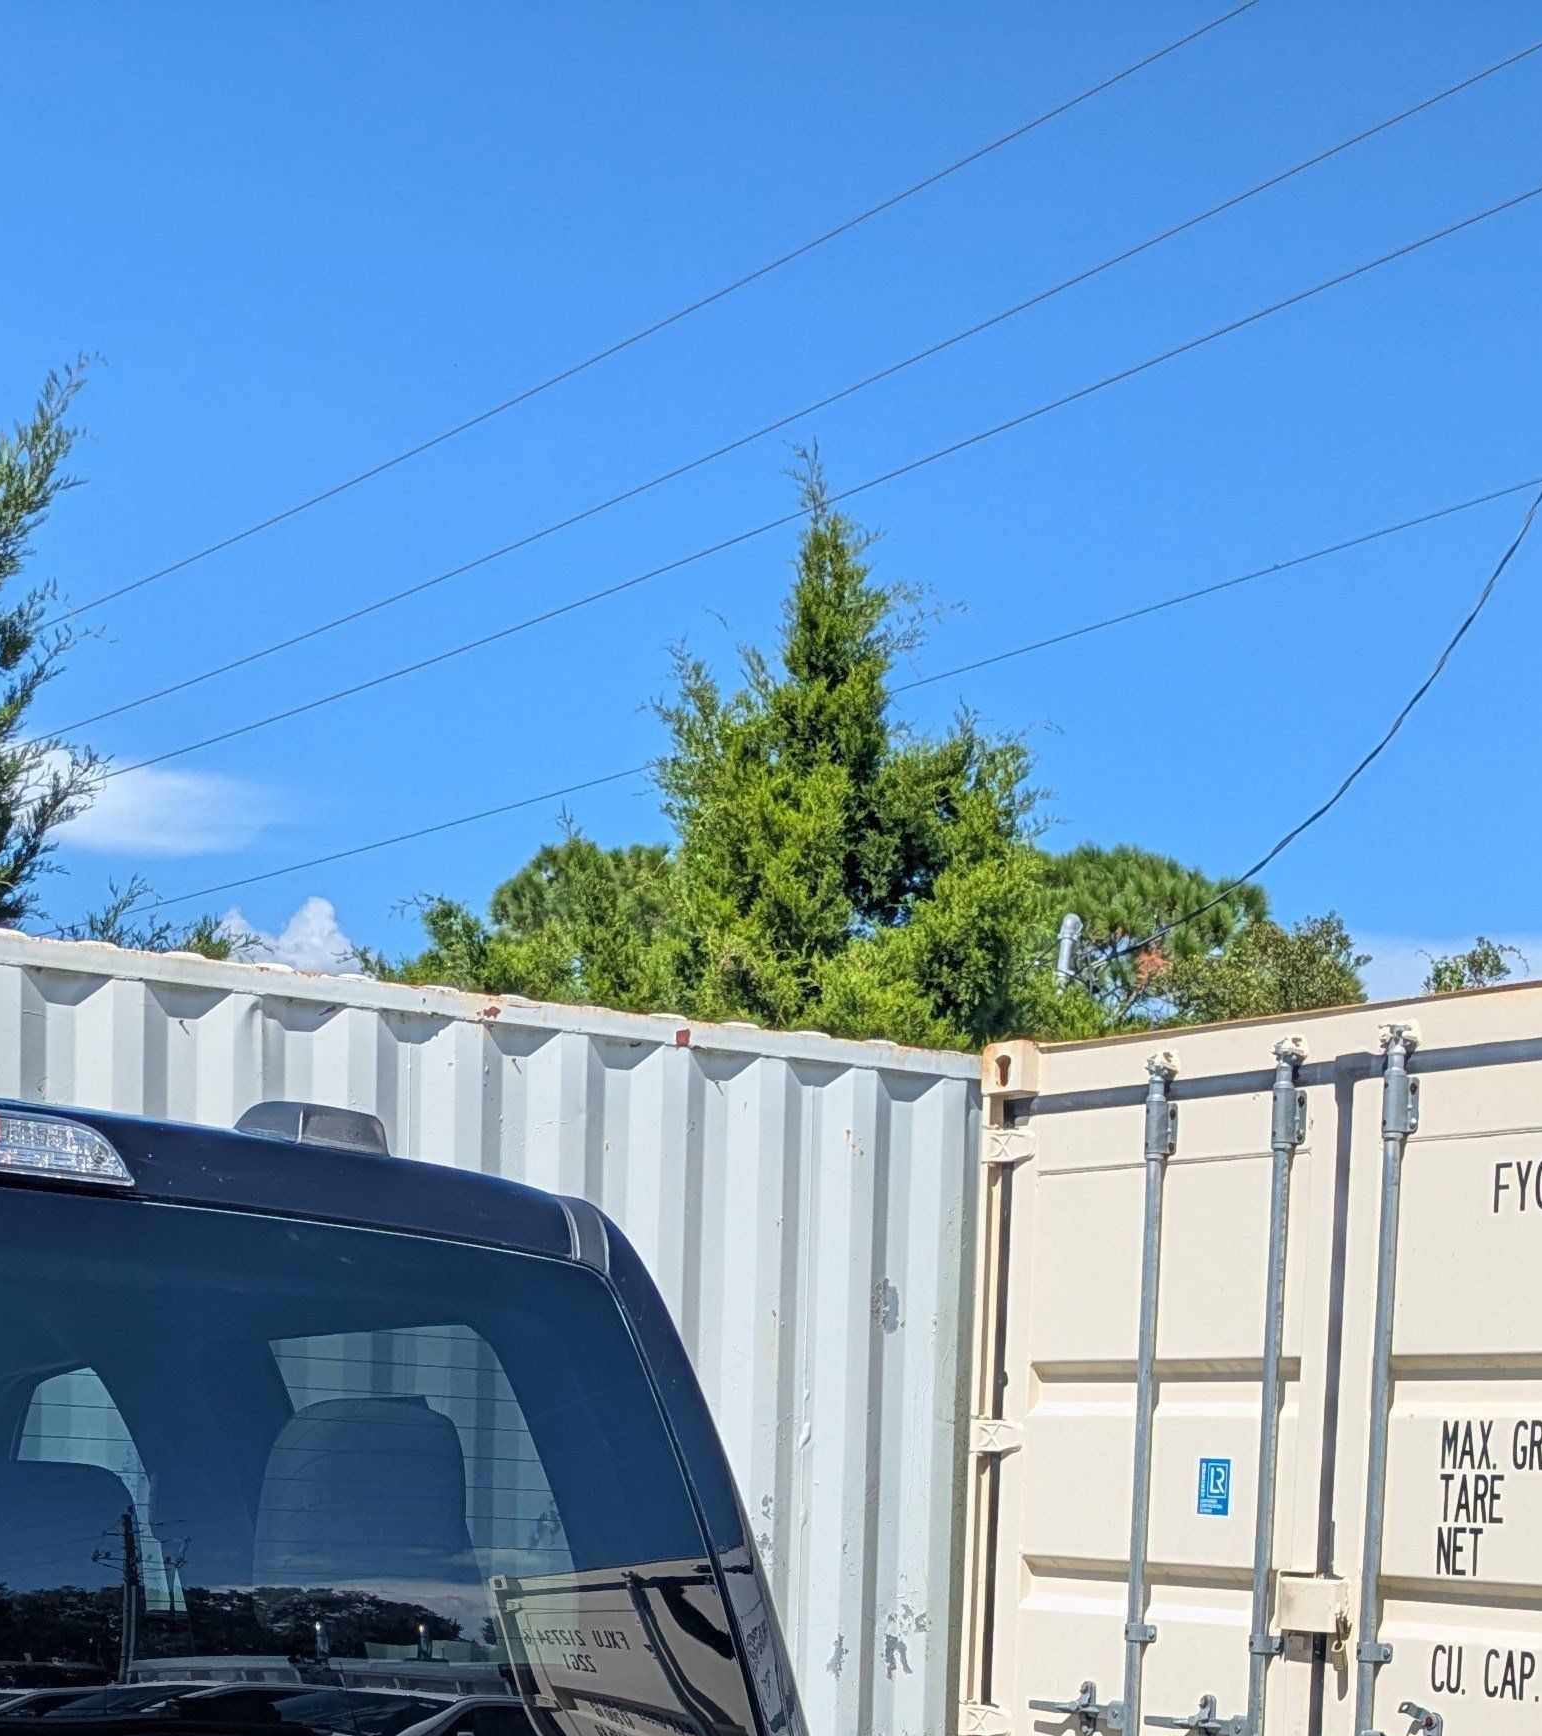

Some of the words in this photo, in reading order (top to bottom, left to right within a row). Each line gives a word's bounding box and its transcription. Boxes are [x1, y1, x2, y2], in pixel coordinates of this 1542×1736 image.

[1440, 1420, 1497, 1470] MAX.
[1210, 1467, 1225, 1493] LR
[1440, 1474, 1504, 1524] TARE
[1437, 1527, 1483, 1576] NET
[1431, 1646, 1465, 1695] CU.
[1484, 1650, 1538, 1703] CAP.
